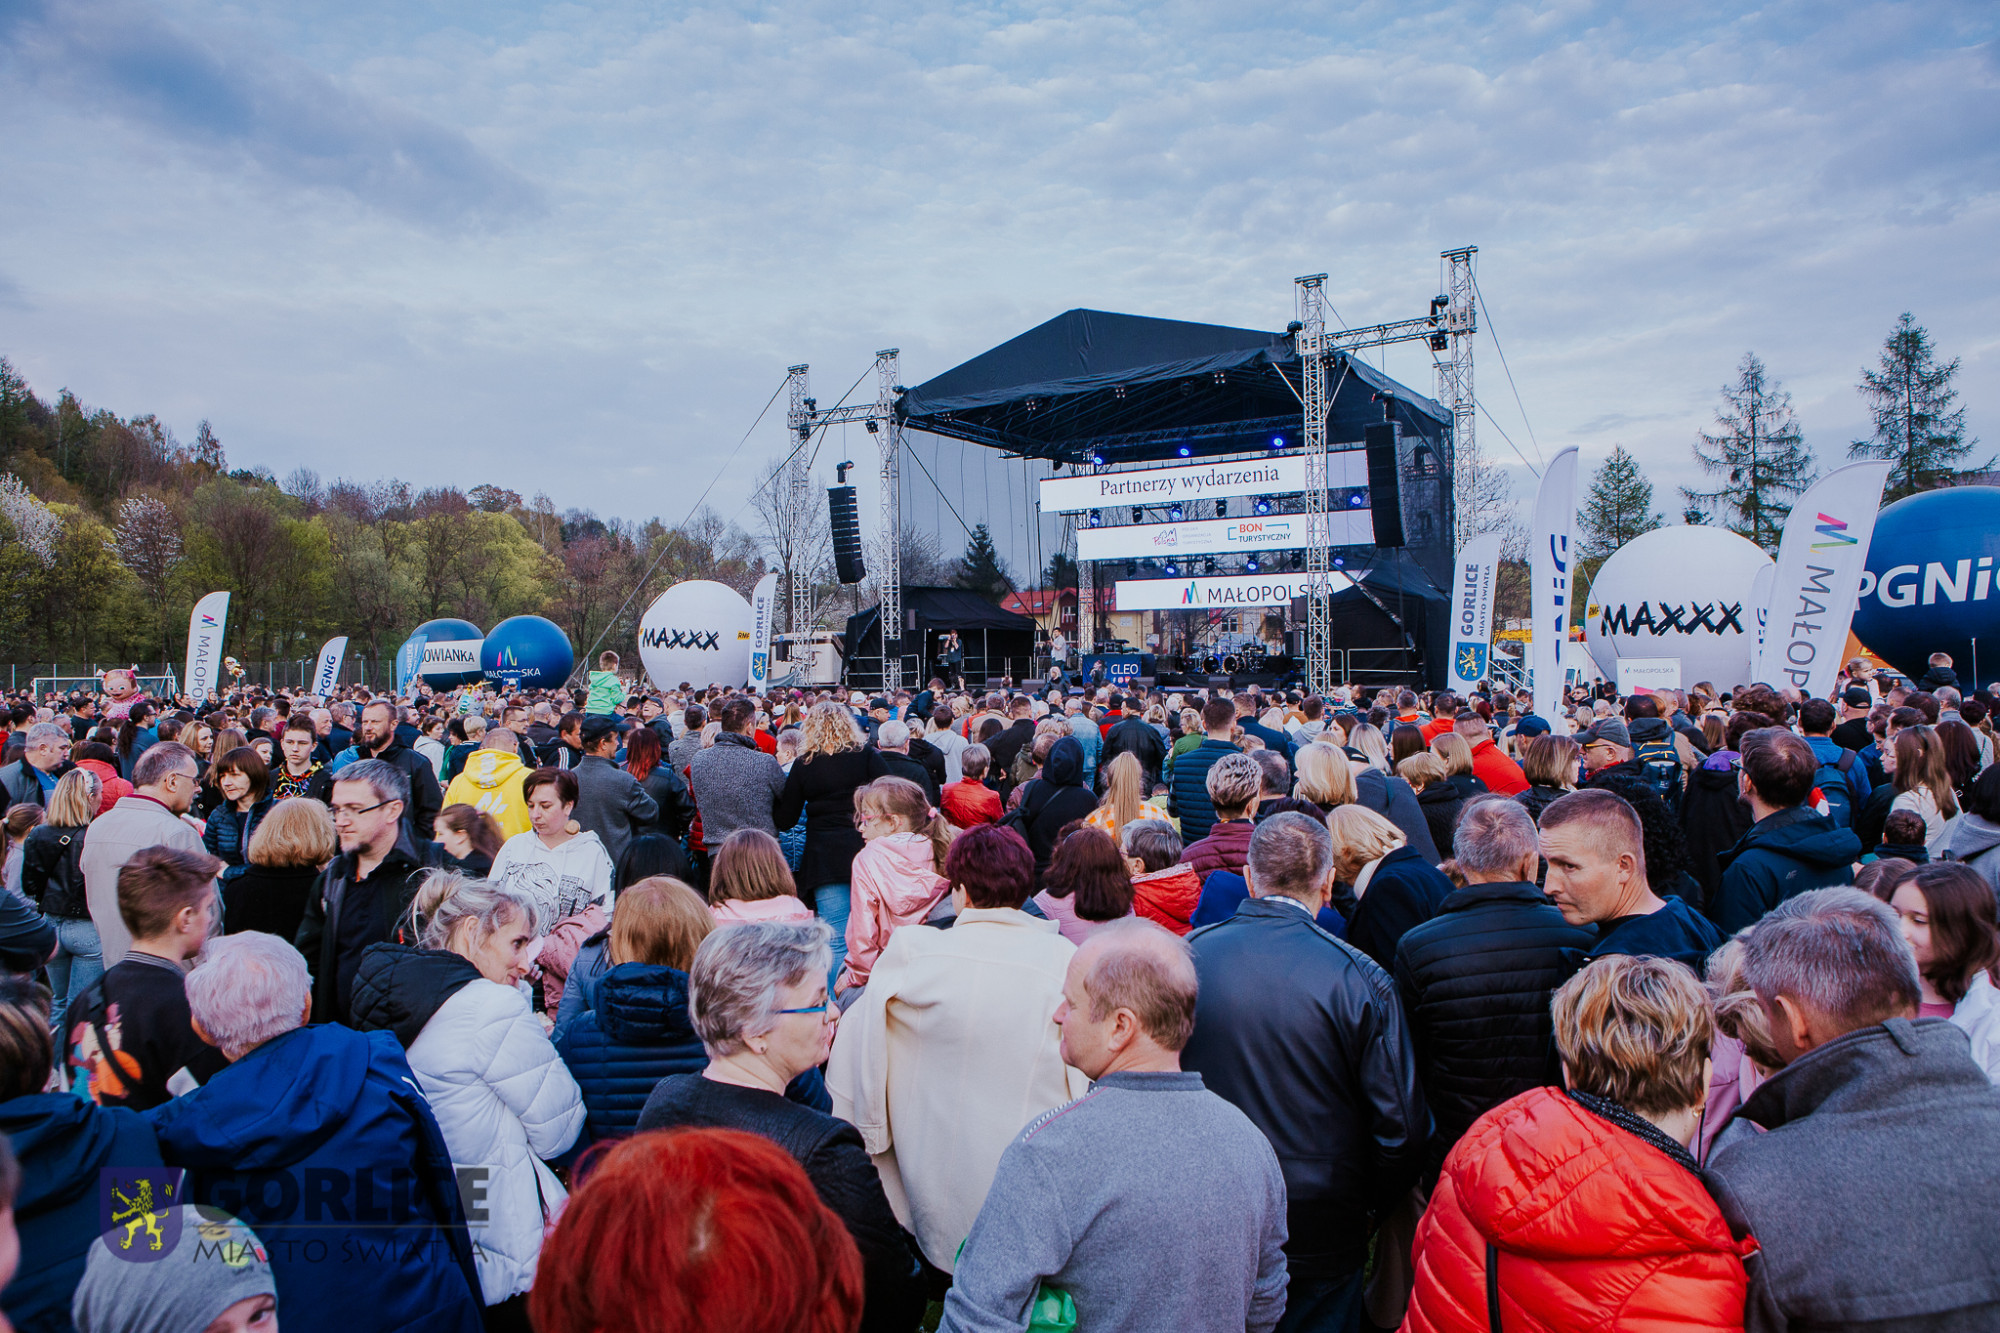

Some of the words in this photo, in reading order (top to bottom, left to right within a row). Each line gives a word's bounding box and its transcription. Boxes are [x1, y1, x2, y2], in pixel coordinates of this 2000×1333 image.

[1100, 477, 1177, 496] Partnerzy
[1182, 465, 1280, 493] wydarzenia
[1239, 523, 1262, 533] BON
[1239, 533, 1292, 543] TURYSTYCZNY
[1480, 565, 1491, 601] ŚWIATŁA
[1855, 557, 2000, 612] PGNi
[1461, 563, 1479, 637] GORLICE
[755, 596, 765, 649] GORLICE
[1478, 603, 1487, 637] MIASTO
[1600, 599, 1744, 637] MAXXX
[642, 627, 720, 651] MAXXX
[422, 648, 475, 663] OWIANKA
[1110, 663, 1139, 675] CLEO
[318, 654, 336, 698] PGNiG
[484, 667, 541, 679] MAŁOSKA
